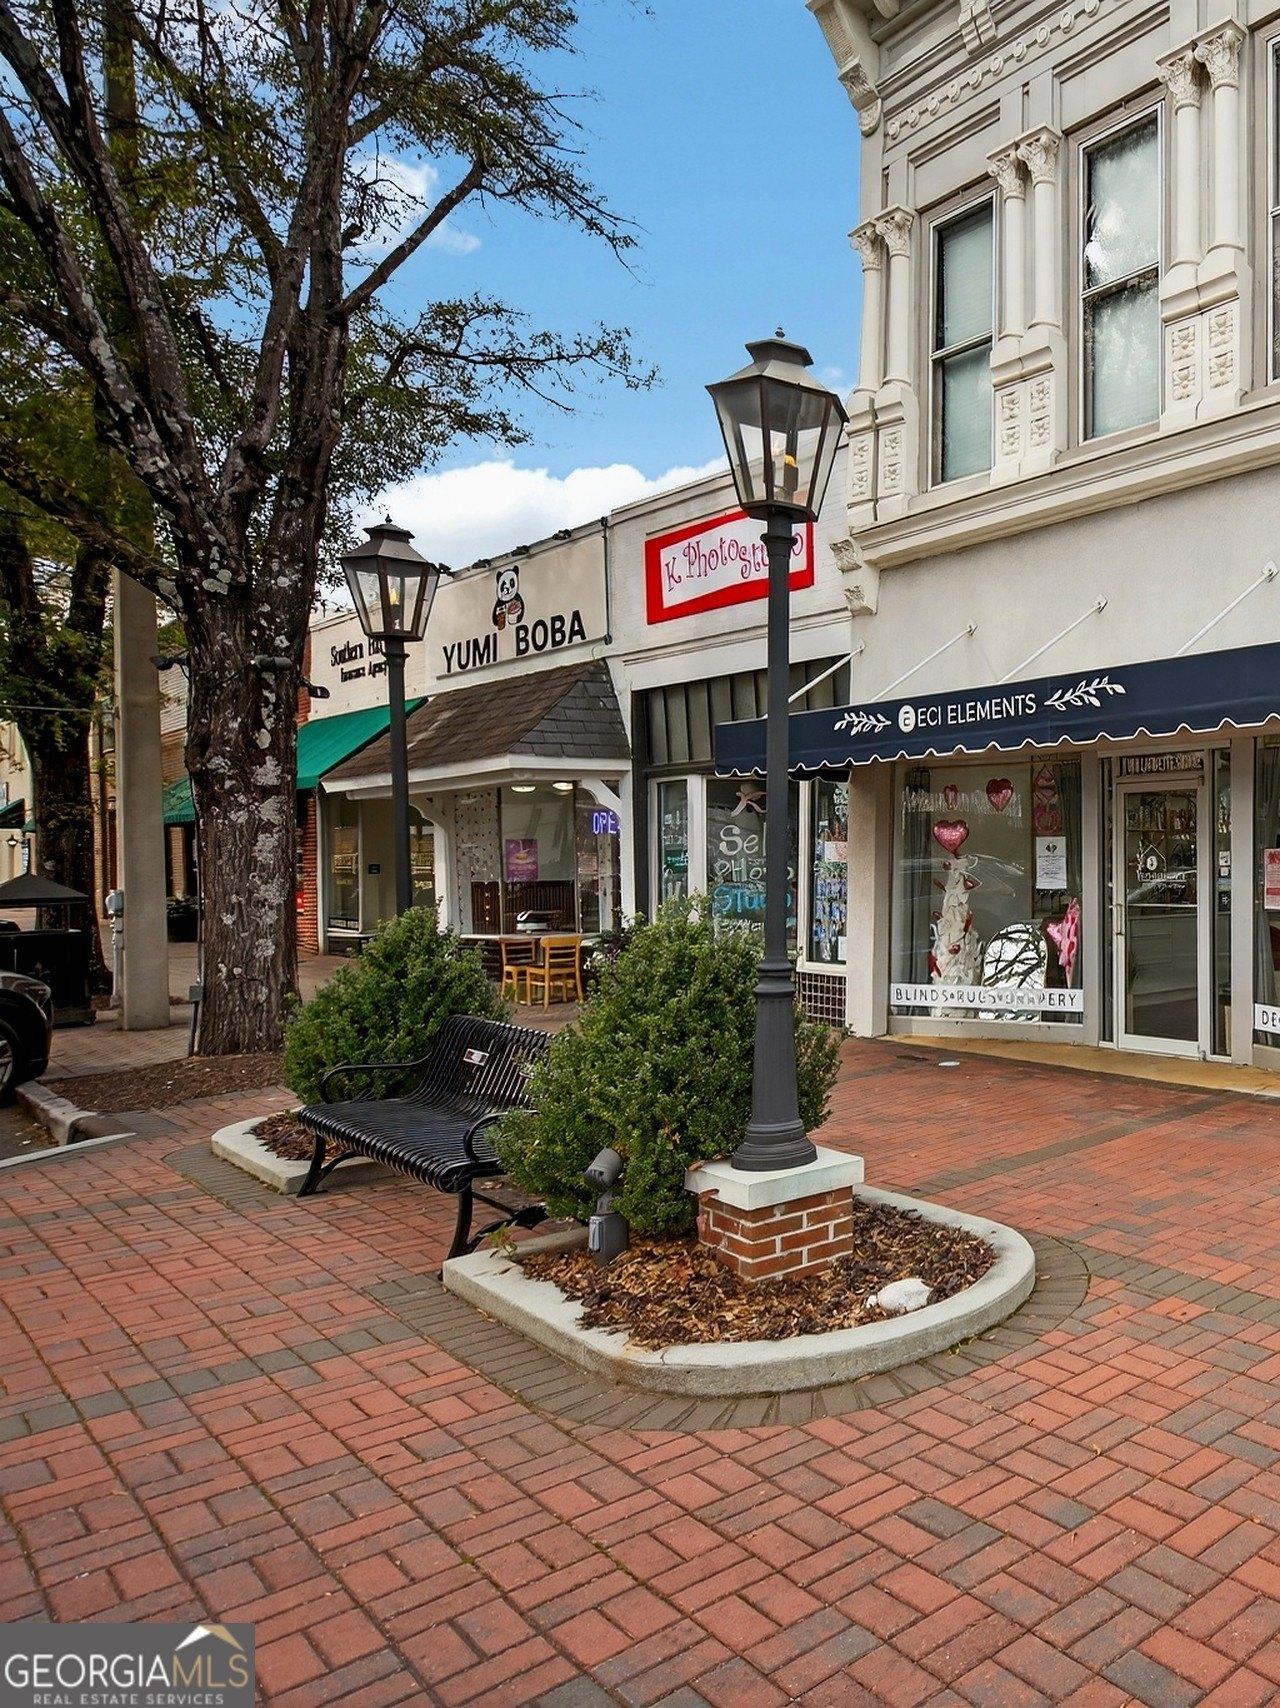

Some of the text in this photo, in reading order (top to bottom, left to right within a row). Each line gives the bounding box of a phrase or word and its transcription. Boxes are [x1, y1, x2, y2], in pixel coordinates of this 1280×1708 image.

[664, 556, 682, 592] K
[442, 609, 587, 673] YUMI BOBA
[947, 693, 1037, 725] ELEMENTS
[592, 811, 620, 835] OPE
[719, 822, 766, 856] Sel
[895, 987, 948, 1002] BLINDS
